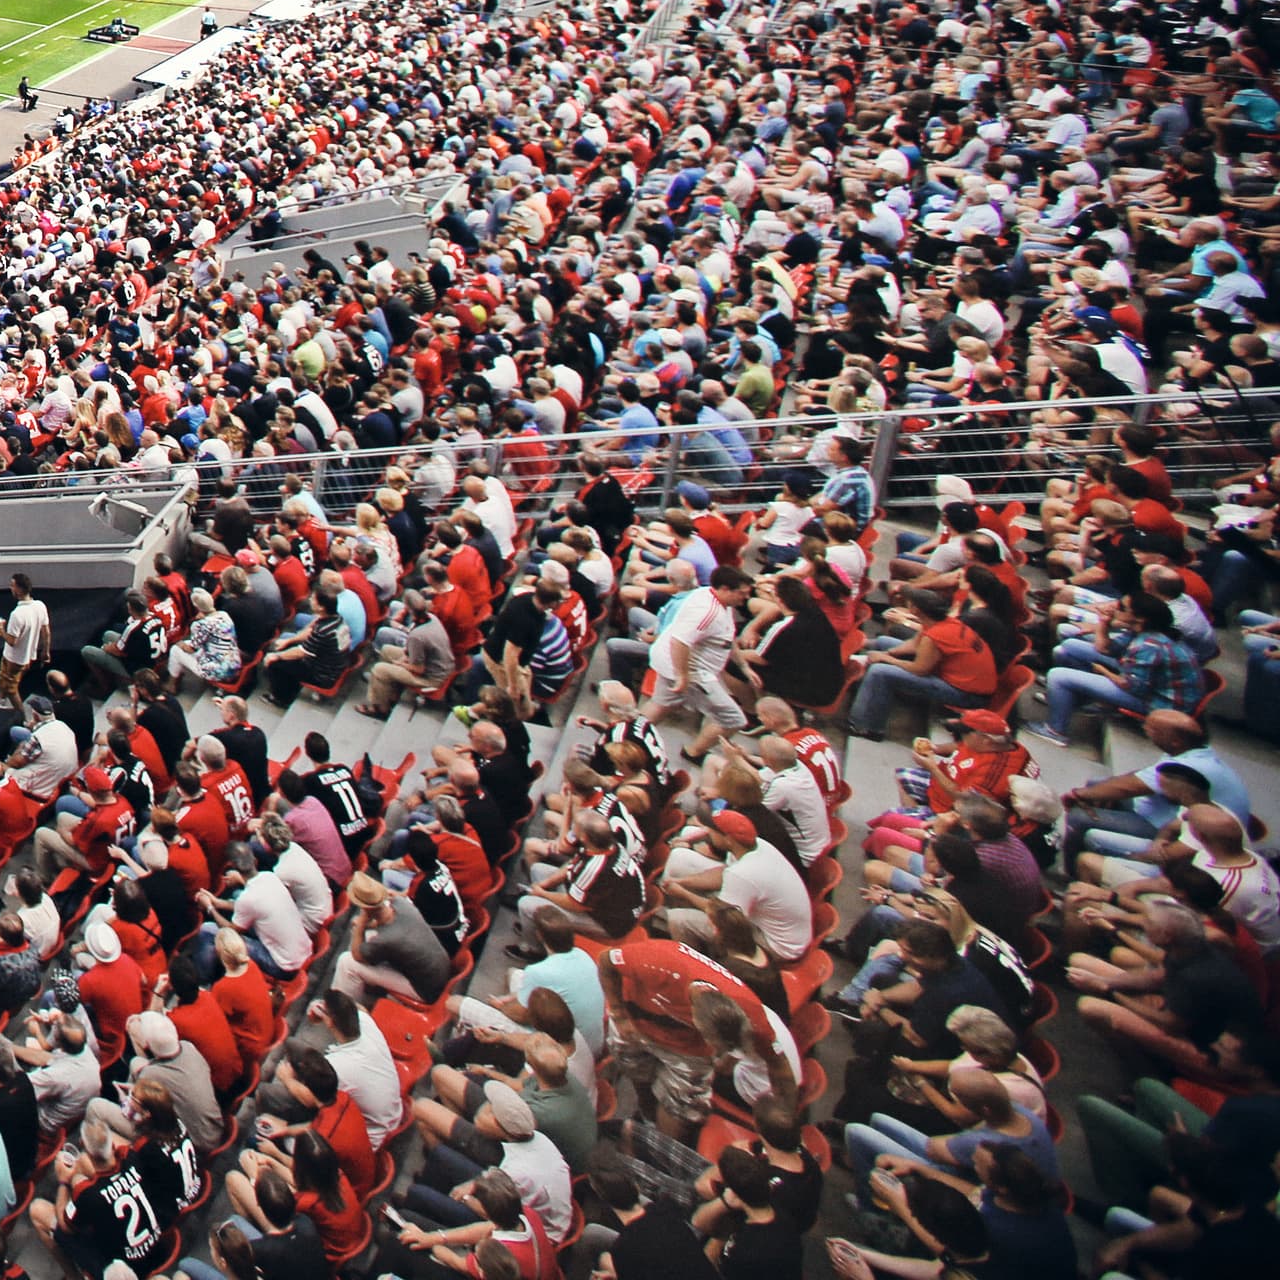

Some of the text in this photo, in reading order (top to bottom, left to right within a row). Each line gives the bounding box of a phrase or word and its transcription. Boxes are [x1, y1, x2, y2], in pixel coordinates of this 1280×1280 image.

[224, 786, 253, 820] 16
[332, 780, 364, 822] 11
[100, 1166, 143, 1204] TOPRAK
[112, 1183, 160, 1249] 21
